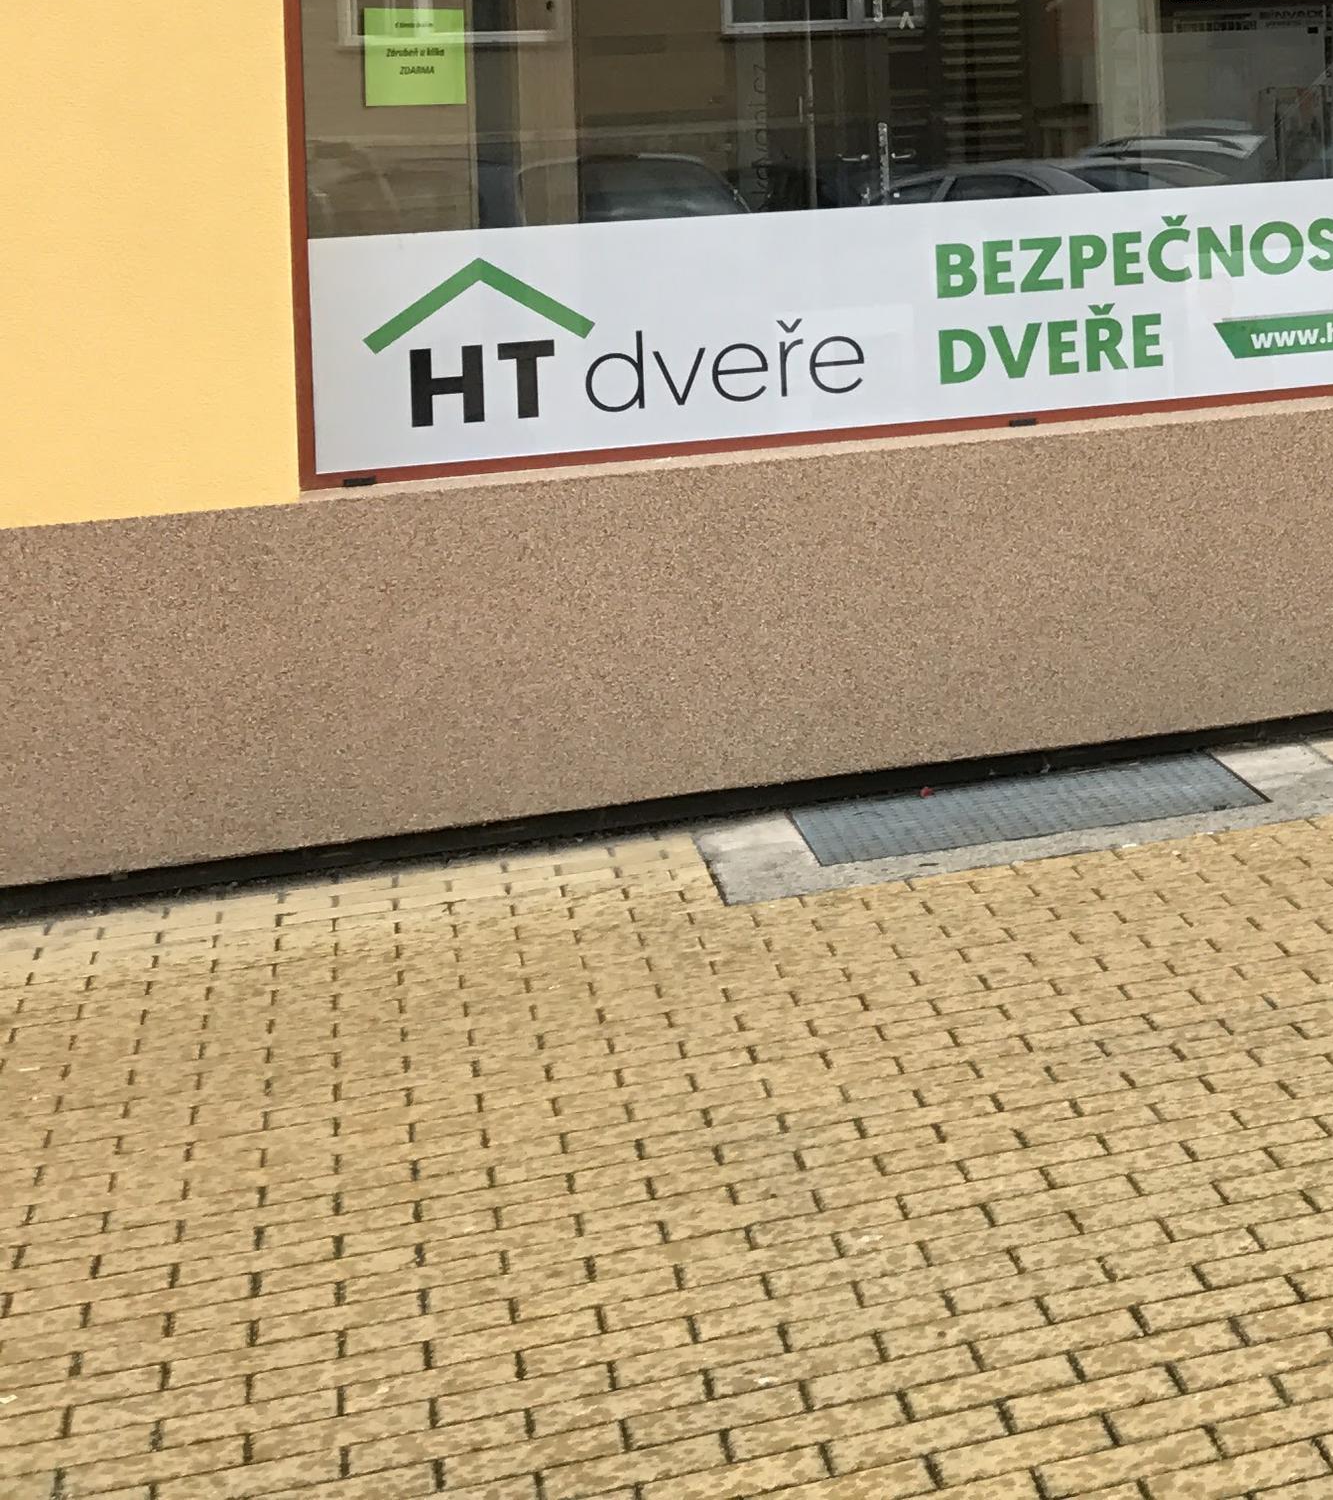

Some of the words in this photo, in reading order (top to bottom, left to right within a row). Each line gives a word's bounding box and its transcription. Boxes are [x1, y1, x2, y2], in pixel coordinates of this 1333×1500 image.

[409, 339, 555, 428] HT
[584, 317, 865, 413] dveře
[938, 303, 1165, 386] DVEŘE
